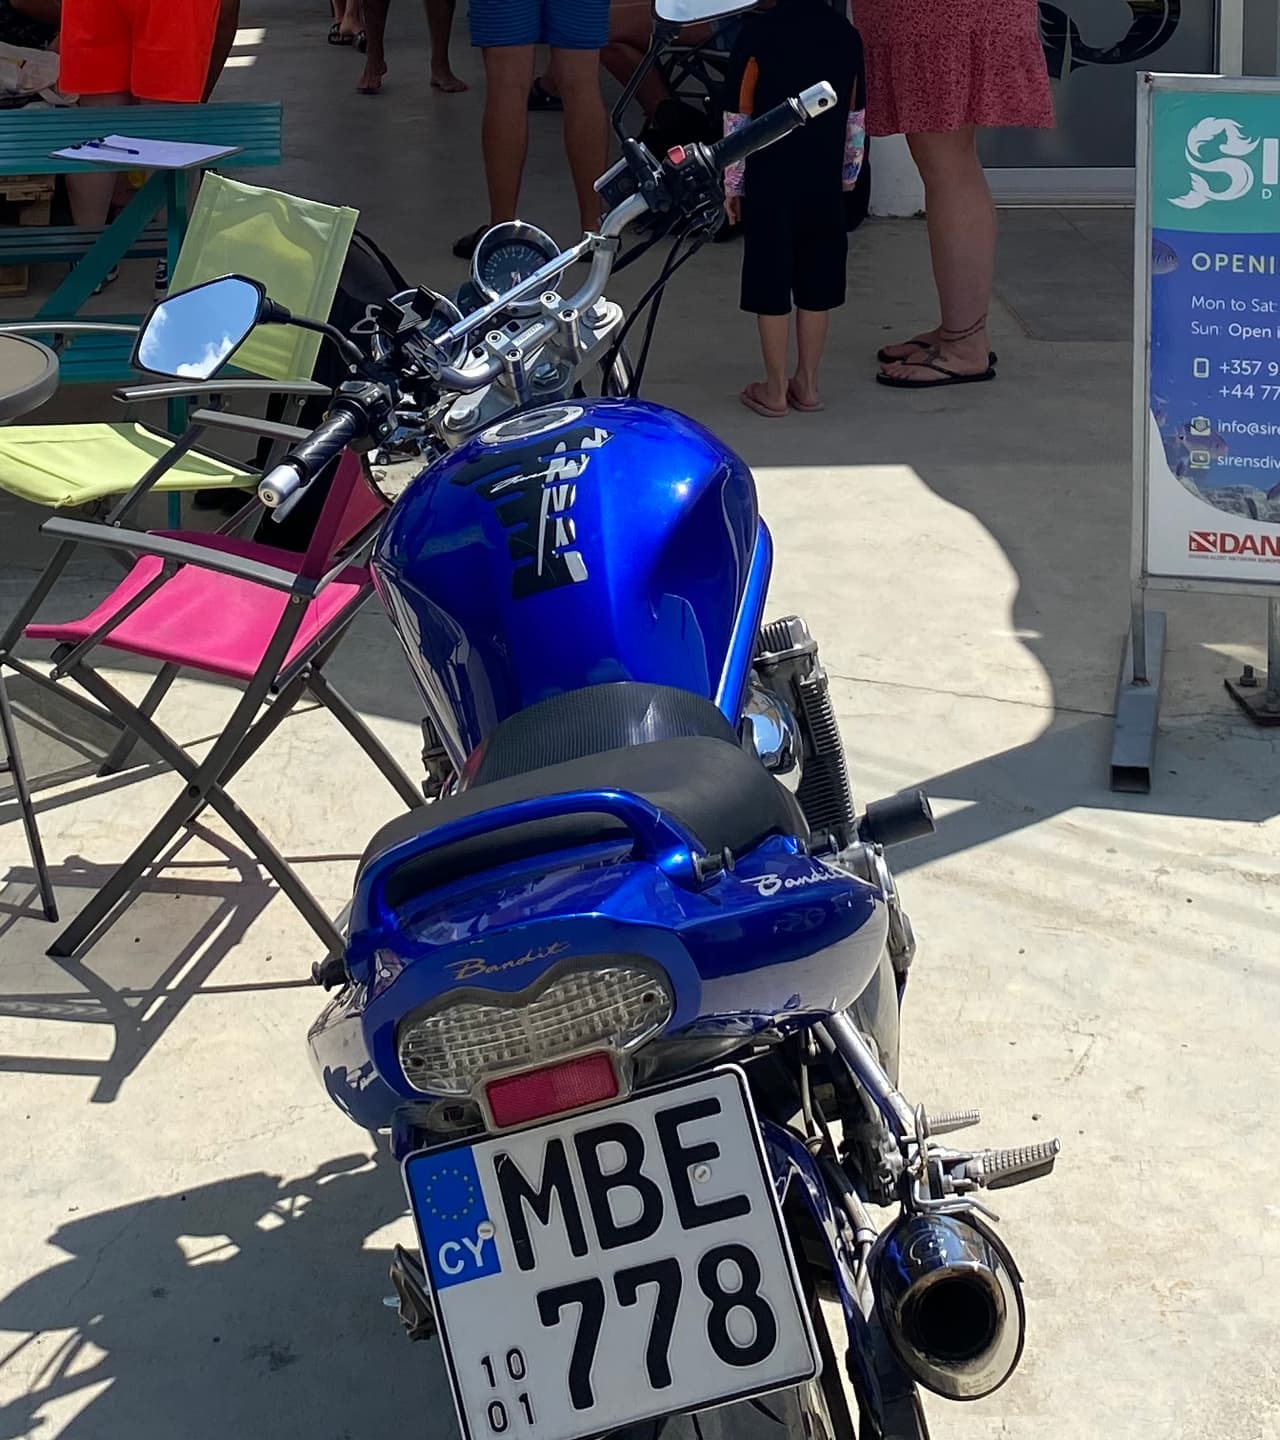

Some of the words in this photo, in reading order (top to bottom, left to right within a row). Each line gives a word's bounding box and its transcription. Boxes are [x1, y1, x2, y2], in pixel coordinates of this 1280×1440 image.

[1191, 296, 1225, 310] Mon
[1230, 298, 1246, 311] to
[1228, 323, 1272, 340] Open
[1219, 360, 1262, 376] +357
[1219, 383, 1255, 400] +44
[444, 941, 570, 980] Bandit
[493, 1096, 752, 1272] MBE
[437, 1236, 488, 1276] CY
[536, 1242, 778, 1411] 778
[480, 1347, 527, 1389] 10
[487, 1392, 535, 1433] 01
